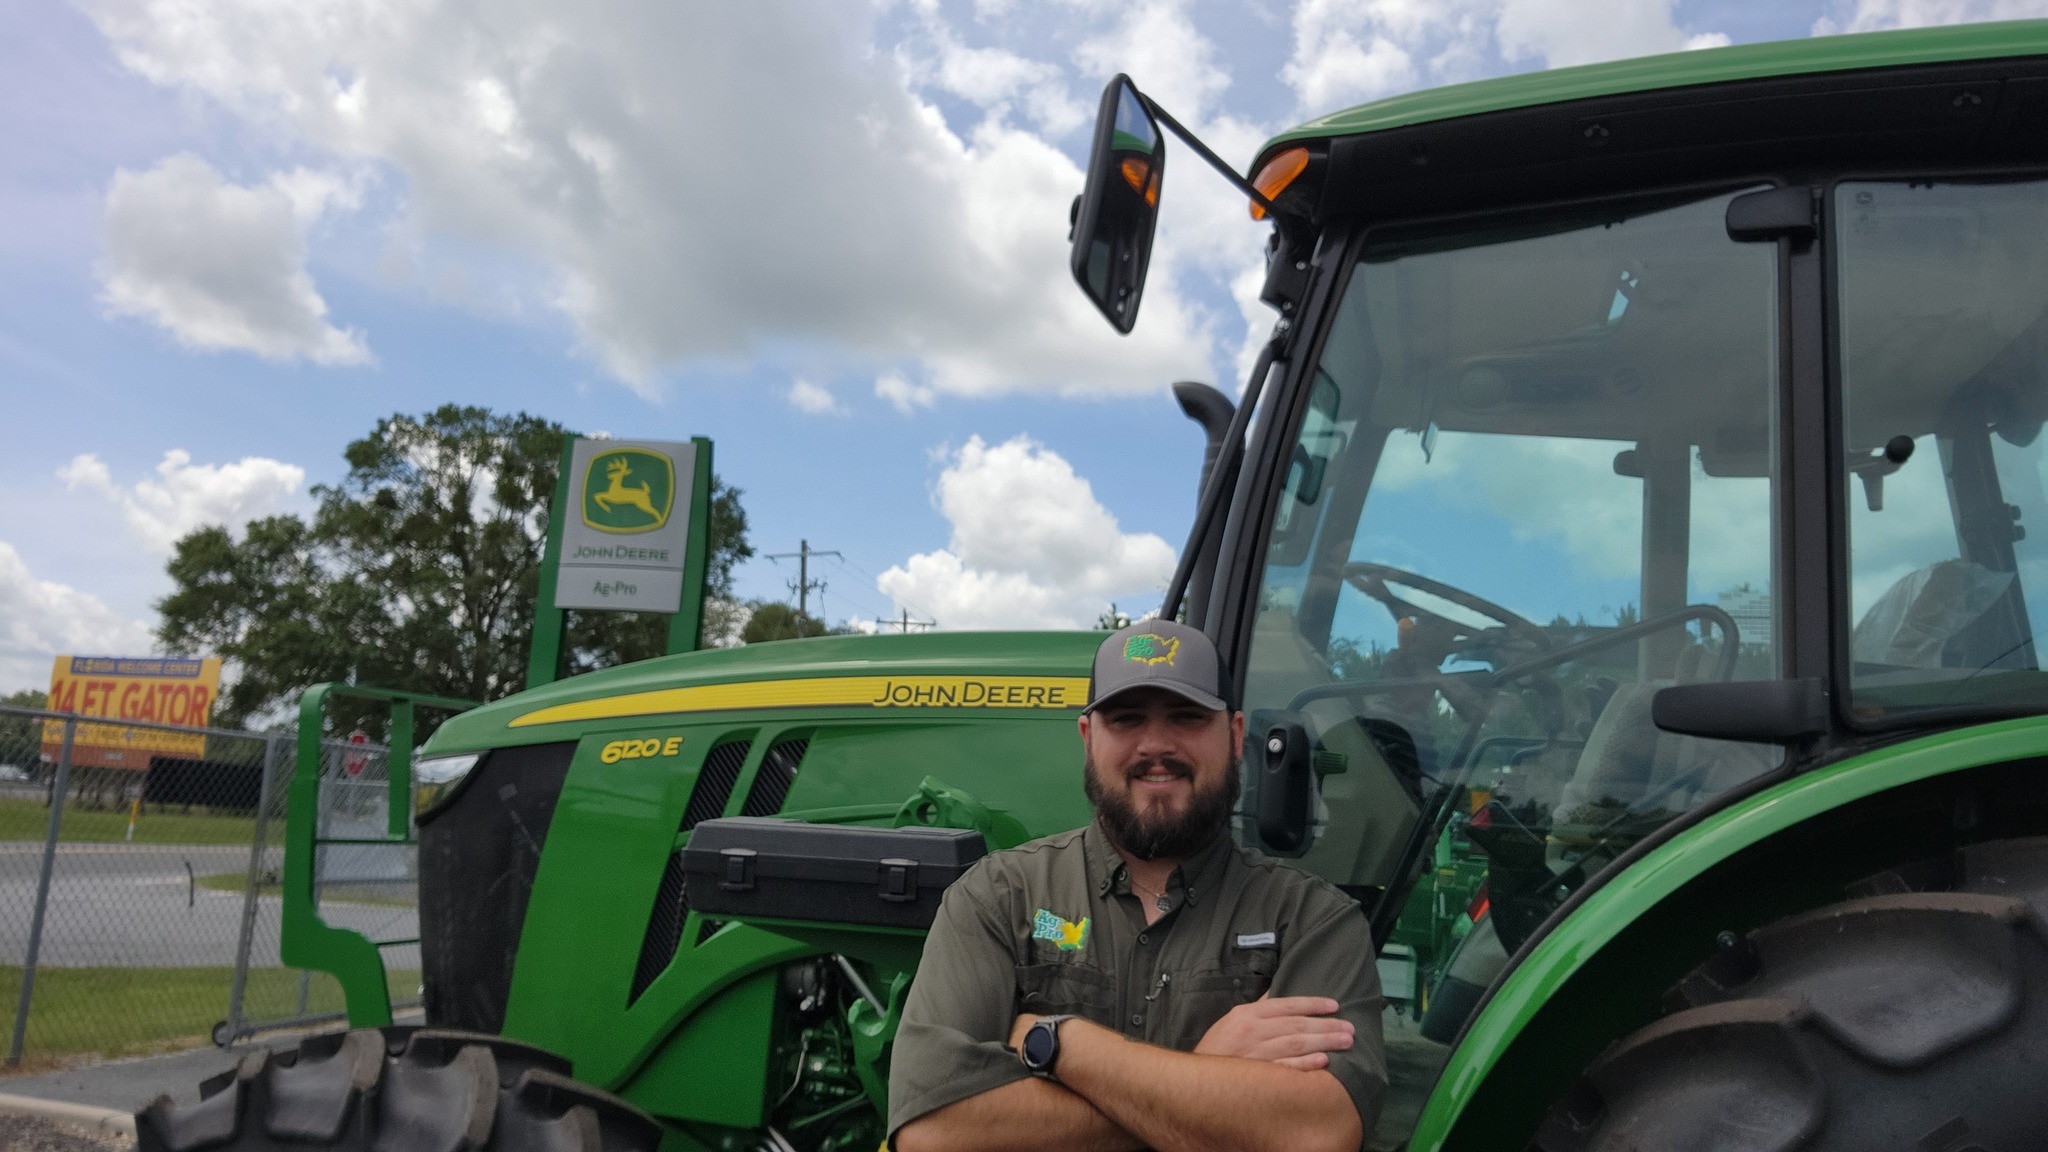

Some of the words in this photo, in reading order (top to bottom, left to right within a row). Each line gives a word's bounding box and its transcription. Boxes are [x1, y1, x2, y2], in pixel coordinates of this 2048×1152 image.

[572, 544, 613, 559] JOHN
[615, 544, 670, 562] DEERE
[117, 660, 163, 675] WELCOME
[163, 661, 199, 676] CENTER
[873, 681, 957, 703] JOHN
[961, 681, 1066, 704] DEERE
[81, 680, 117, 718] FT
[120, 682, 209, 728] GATOR
[601, 738, 661, 764] 6120
[662, 736, 683, 756] E
[1034, 924, 1064, 940] Pro
